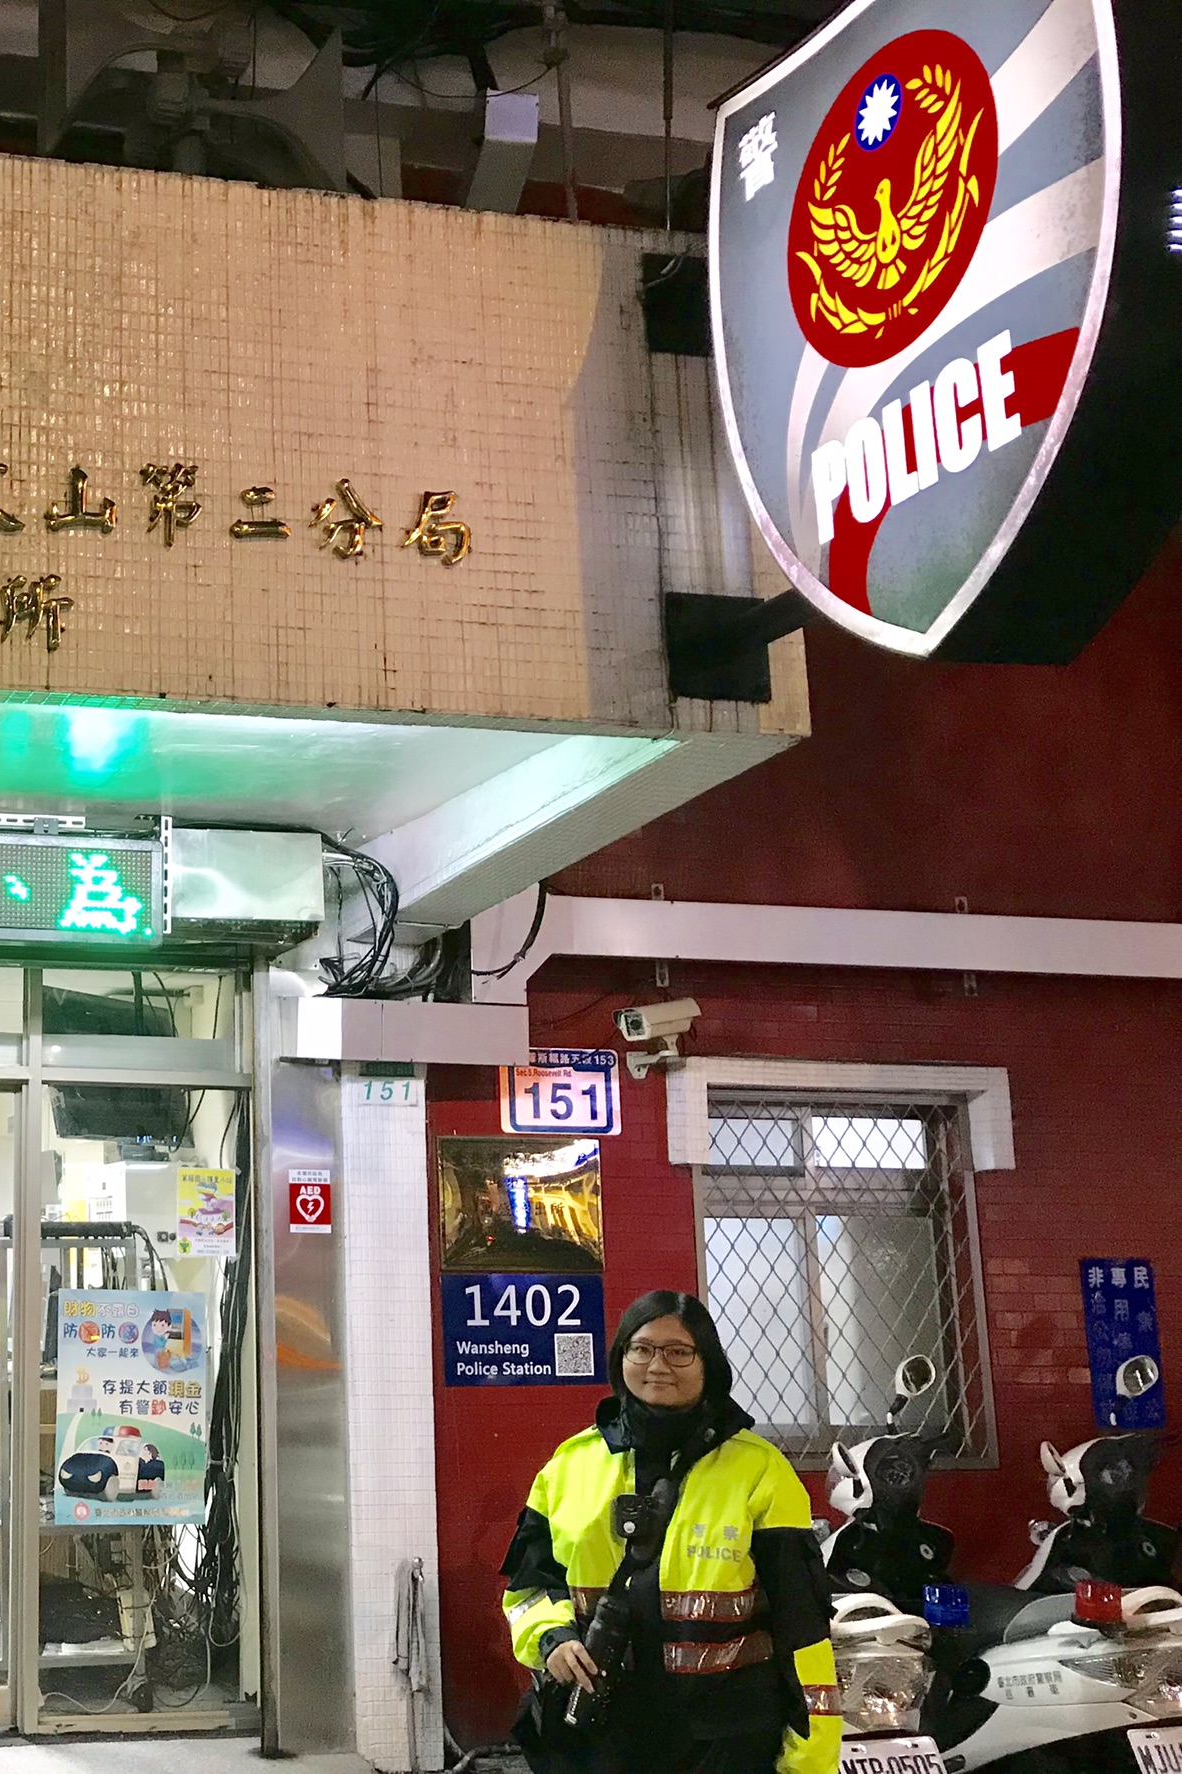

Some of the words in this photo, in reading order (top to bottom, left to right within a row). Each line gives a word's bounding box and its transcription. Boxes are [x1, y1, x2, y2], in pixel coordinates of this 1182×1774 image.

[811, 329, 1022, 545] POLICE
[594, 1055, 615, 1066] 153
[364, 1080, 410, 1101] 151
[524, 1082, 598, 1121] 151
[299, 1185, 321, 1195] AED
[464, 1284, 581, 1326] 1402
[86, 1346, 139, 1358] 大家一起來
[457, 1340, 530, 1357] Wansheng
[456, 1360, 499, 1376] Police
[502, 1360, 552, 1377] Station
[102, 1379, 202, 1399] 存提大額現金
[686, 1544, 742, 1563] POLICE
